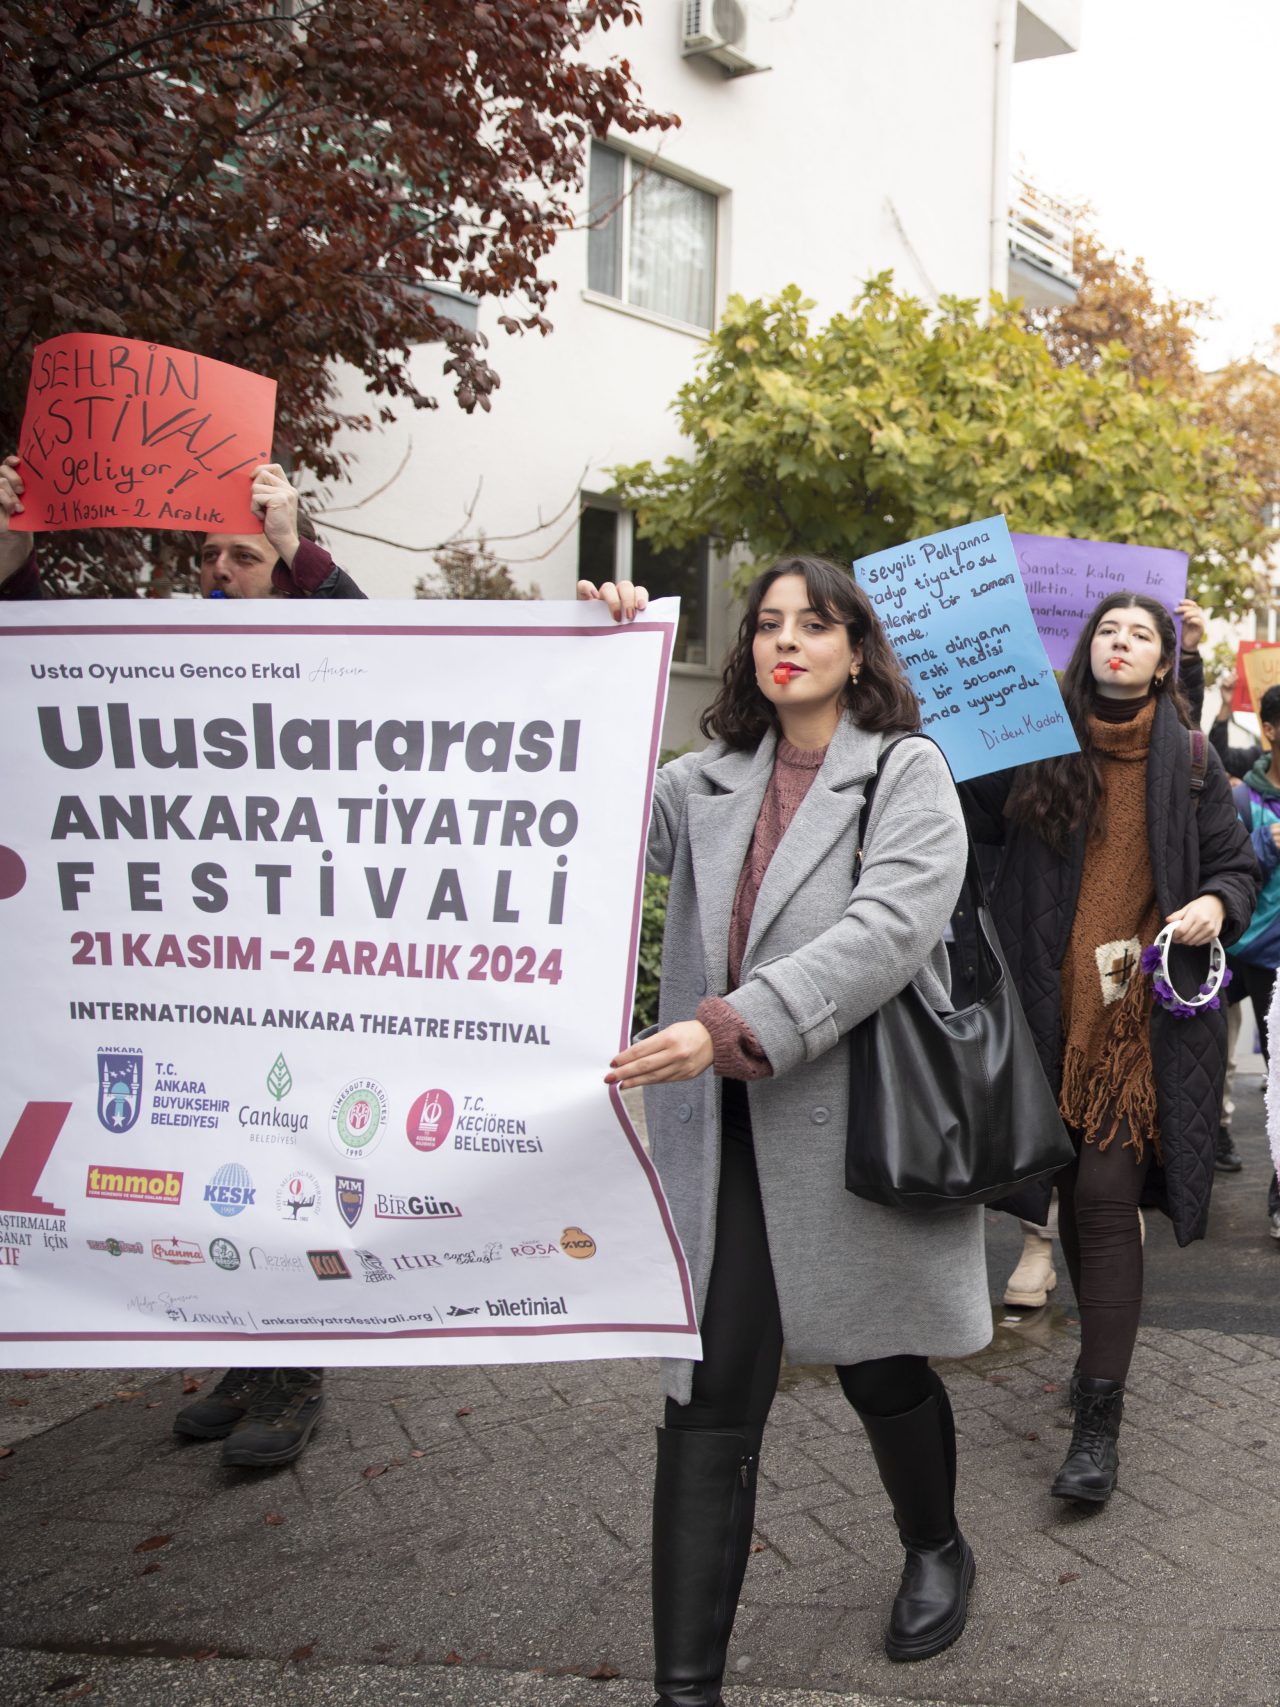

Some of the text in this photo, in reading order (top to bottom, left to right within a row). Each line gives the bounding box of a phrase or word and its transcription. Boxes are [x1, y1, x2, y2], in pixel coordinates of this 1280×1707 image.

[34, 345, 198, 400] ŞEHRİN
[44, 503, 68, 524] 21
[159, 502, 225, 523] Aralık
[920, 532, 990, 565] Pollyanna
[939, 594, 961, 610] bir
[945, 622, 1011, 656] dünyanın
[919, 639, 1005, 681] eski kedisi
[30, 663, 83, 679] Usta
[88, 663, 175, 684] Oyuncu
[179, 662, 247, 679] Genco
[252, 662, 301, 679] Erkal
[932, 684, 953, 700] bir
[963, 663, 1017, 691] sobanın
[37, 702, 581, 773] Uluslararası
[50, 783, 579, 847] ANKARA TİYATRO
[57, 849, 569, 925] FESTİVALİ
[70, 930, 113, 966] 21
[122, 933, 262, 971] KASIM
[322, 939, 462, 981] ARALIK
[467, 944, 563, 985] 2024
[70, 1001, 550, 1046] INTERNATIONAL ANKARA THEATRE FESTIVAL
[97, 1046, 143, 1054] ANKARA
[155, 1063, 177, 1075] T.C.
[154, 1080, 206, 1095] ANKARA
[463, 1096, 484, 1111] T.C.
[150, 1112, 219, 1129] BELEDİYESİ
[238, 1105, 309, 1134] Çankaya
[456, 1112, 526, 1136] KEÇİÖREN
[454, 1133, 544, 1153] BELEDİYESİ
[90, 1168, 180, 1196] tmmob
[338, 1179, 362, 1192] MM
[203, 1184, 257, 1205] KESK
[43, 1232, 68, 1251] İÇİN
[510, 1243, 559, 1257] ROSA
[485, 1296, 568, 1317] biletinial
[262, 1312, 433, 1327] ankaratiyatrofestivali.org
